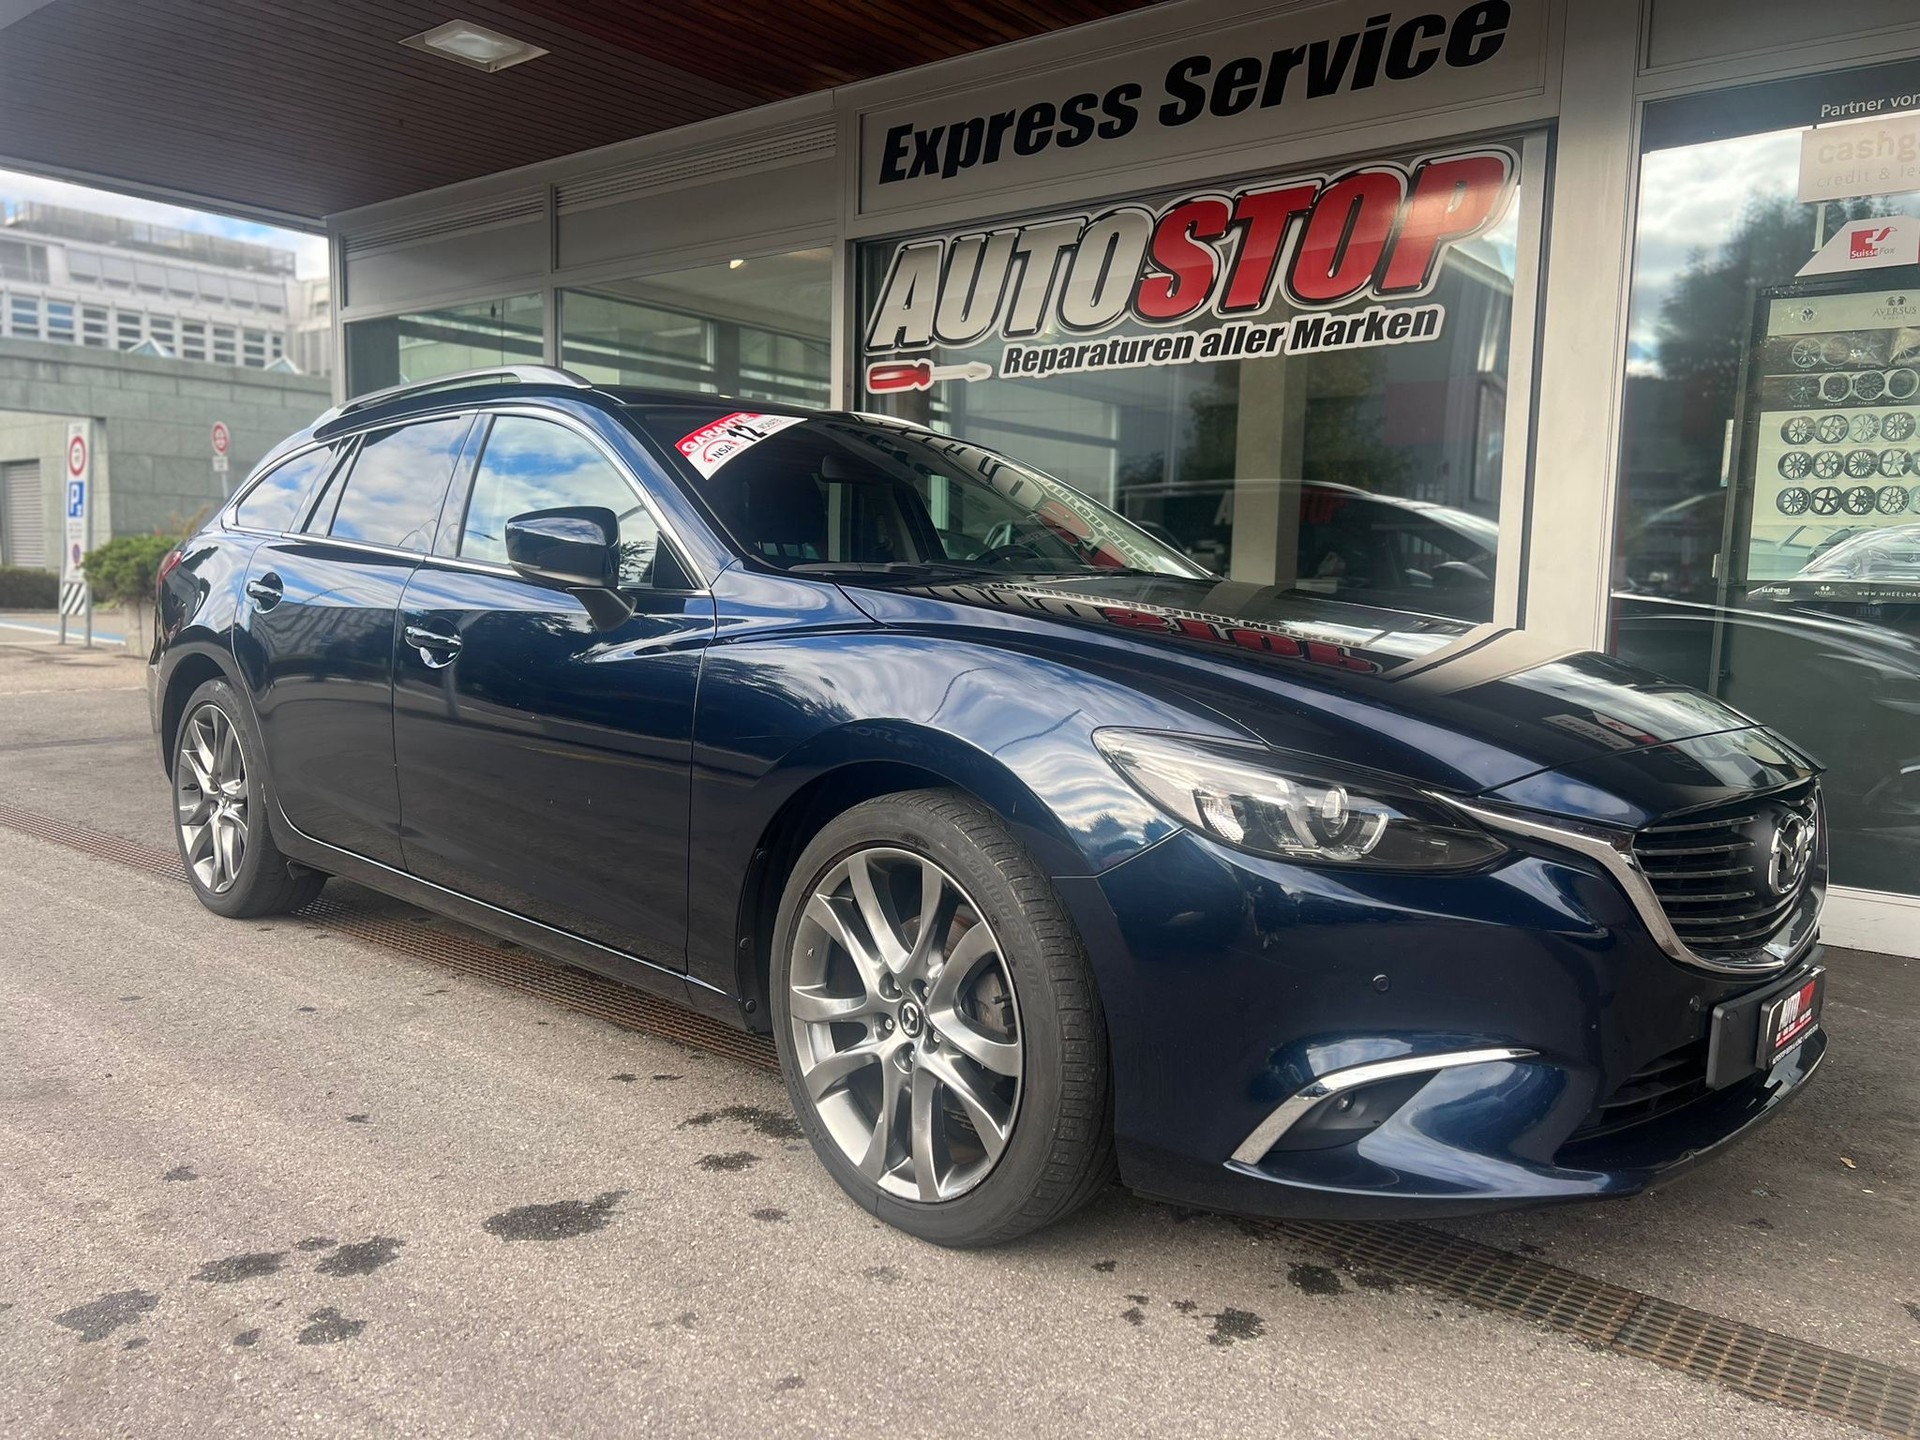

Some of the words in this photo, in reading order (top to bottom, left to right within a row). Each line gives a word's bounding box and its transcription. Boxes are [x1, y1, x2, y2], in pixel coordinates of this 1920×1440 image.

[879, 82, 1142, 185] Express
[1158, 0, 1511, 127] Service
[1821, 98, 1885, 118] Partner
[1818, 131, 1920, 164] cashg
[1816, 167, 1870, 188] credit
[1879, 167, 1890, 180] &
[1900, 164, 1920, 177] le
[865, 150, 1513, 352] AUTOSTOP
[1003, 331, 1192, 375] Reparaturen
[1200, 325, 1285, 357] aller
[1290, 308, 1439, 350] Marken
[681, 413, 755, 453] GARANTIE
[727, 424, 768, 443] 12
[711, 444, 735, 459] NSA
[967, 859, 1040, 996] BRIDGESTONE
